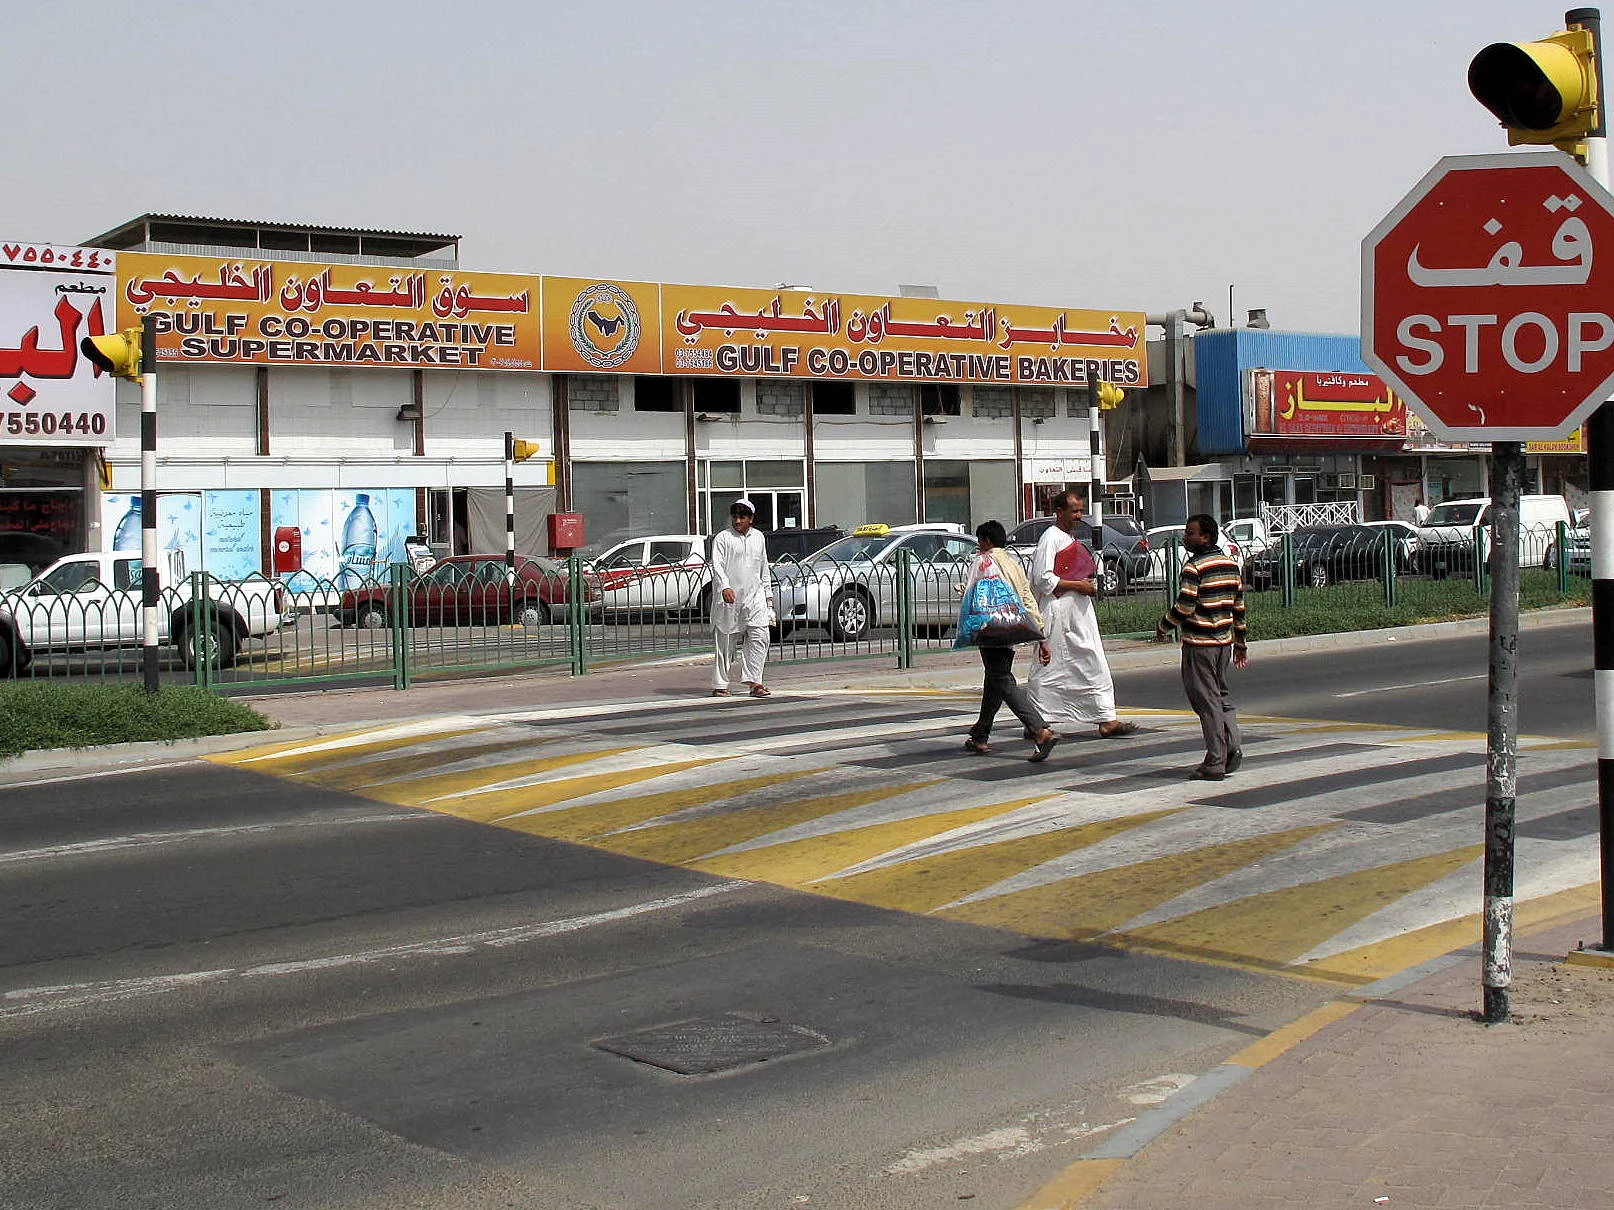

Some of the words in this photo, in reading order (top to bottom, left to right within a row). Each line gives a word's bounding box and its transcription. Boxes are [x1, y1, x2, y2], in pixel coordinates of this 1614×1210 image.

[1408, 194, 1593, 287] قف
[55, 281, 106, 296] مطعم
[127, 265, 273, 313] الخليجي
[280, 267, 425, 312] التعاون
[433, 277, 528, 319] سوق
[150, 312, 247, 335] GULF
[259, 316, 515, 345] CO-OPERATIVE
[676, 296, 839, 344] الخليجي
[847, 302, 995, 343] التعاون
[998, 312, 1139, 351] مخابز
[181, 338, 484, 364] SUPERMARKET
[716, 345, 798, 373] GULF
[808, 348, 1011, 380] CO-OPERATIVE
[1018, 357, 1140, 383] BAKERIES
[1396, 312, 1614, 375] STOP
